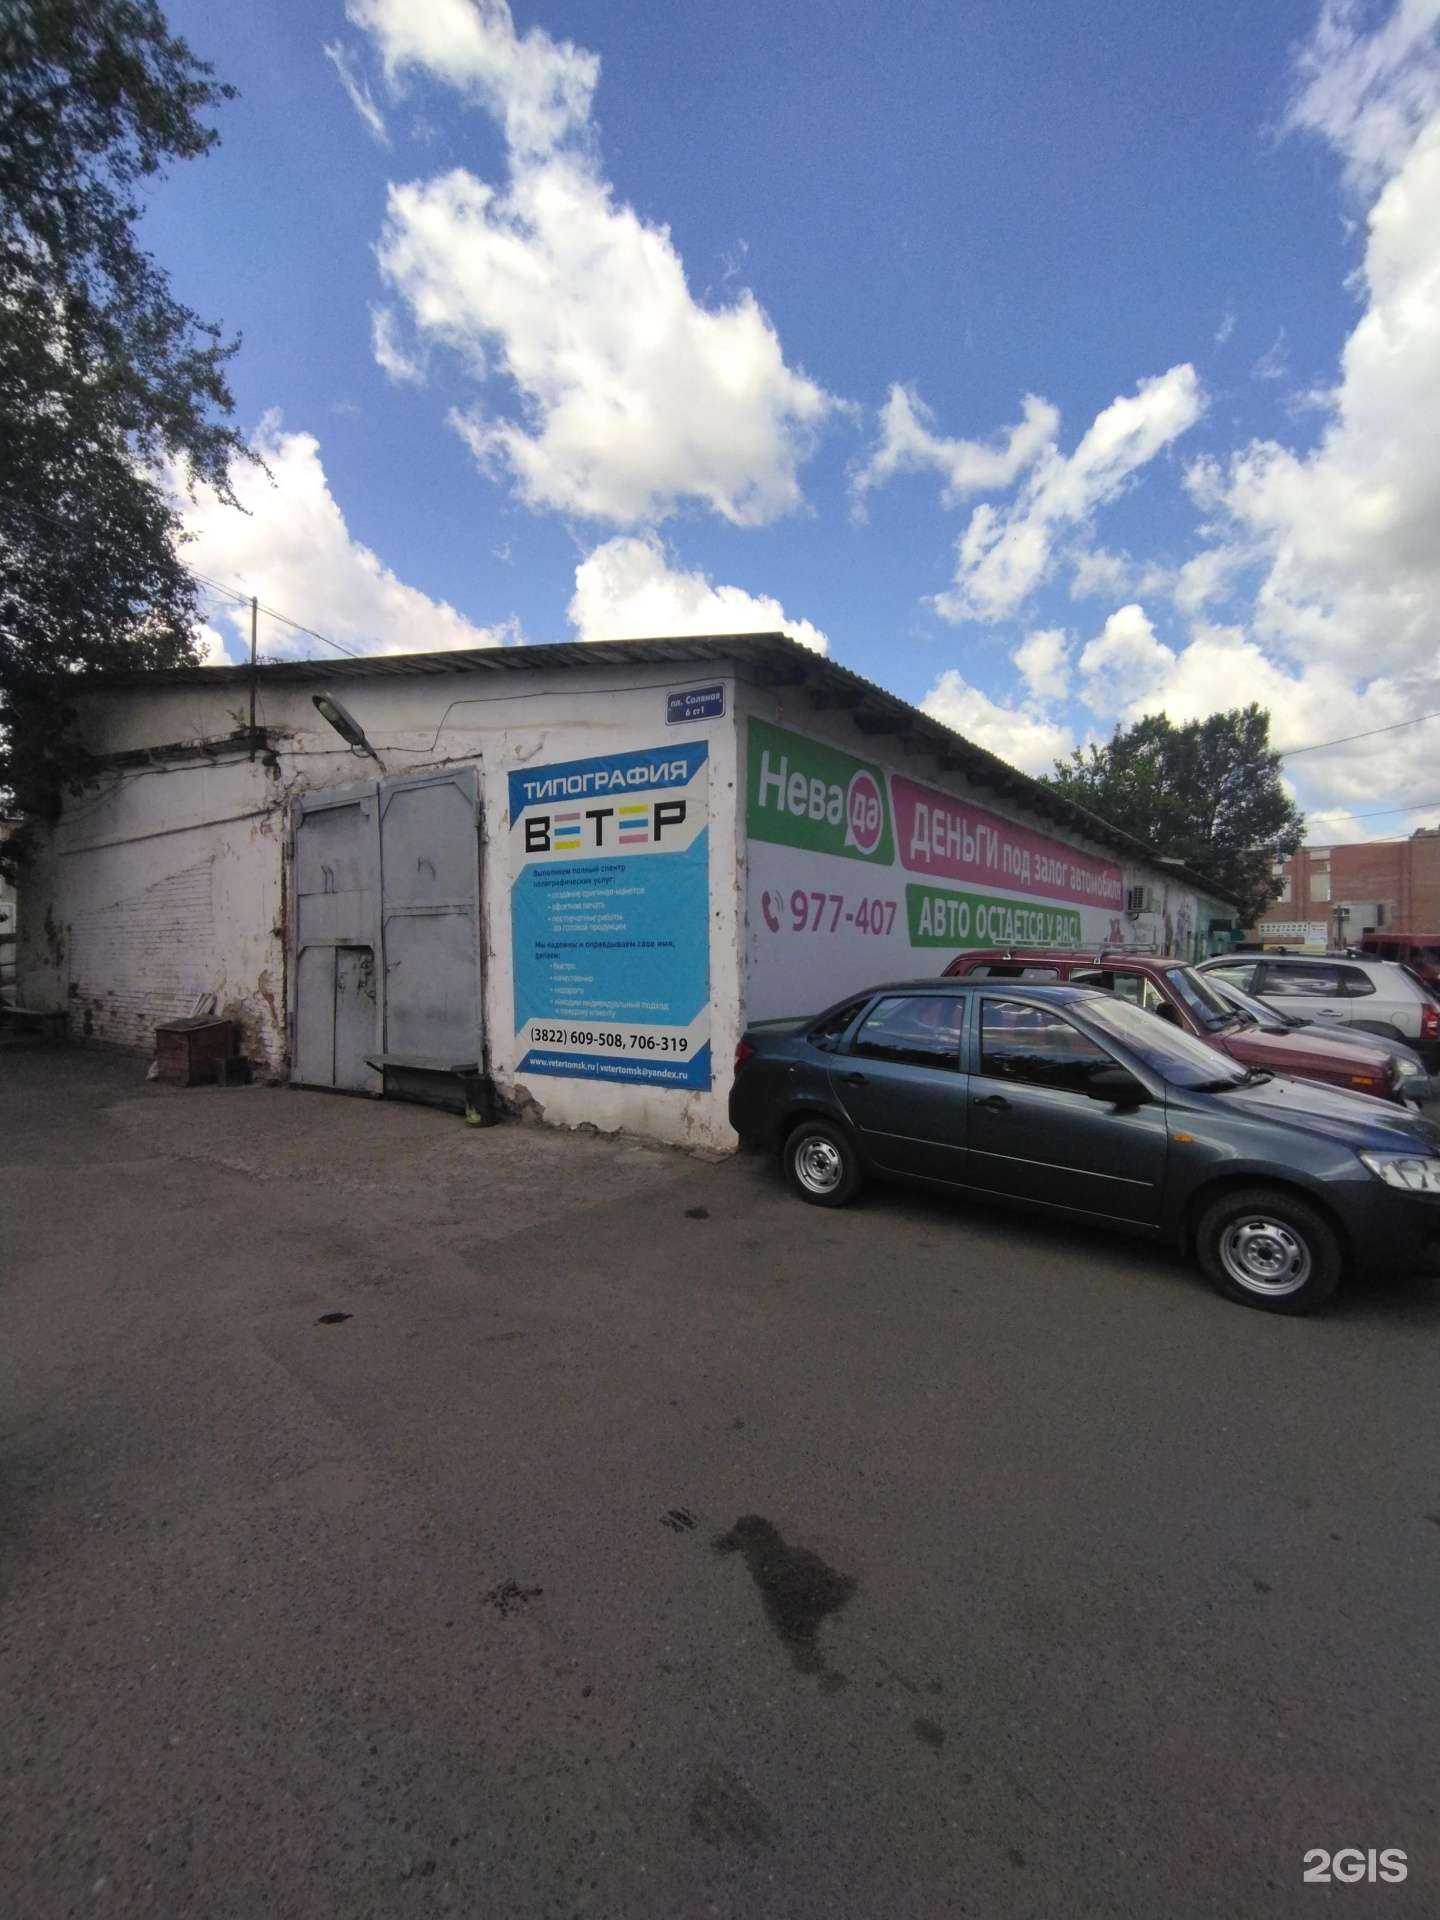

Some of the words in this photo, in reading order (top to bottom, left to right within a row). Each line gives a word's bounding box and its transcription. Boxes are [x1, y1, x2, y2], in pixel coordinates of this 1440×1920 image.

[523, 760, 688, 800] ТИПОГРАФИЯ
[524, 799, 687, 854] ВЕТЕР
[1002, 843, 1031, 885] под
[1034, 853, 1067, 888] залог
[790, 889, 897, 935] 977-407
[918, 896, 970, 938] АВТО
[530, 1027, 567, 1046] (3822)
[570, 1031, 626, 1050] 609-508,
[629, 1034, 688, 1052] 706-319
[529, 1057, 595, 1072] www.vetertomsk.ru
[600, 1063, 689, 1081] vetertomsk@yandex.ru
